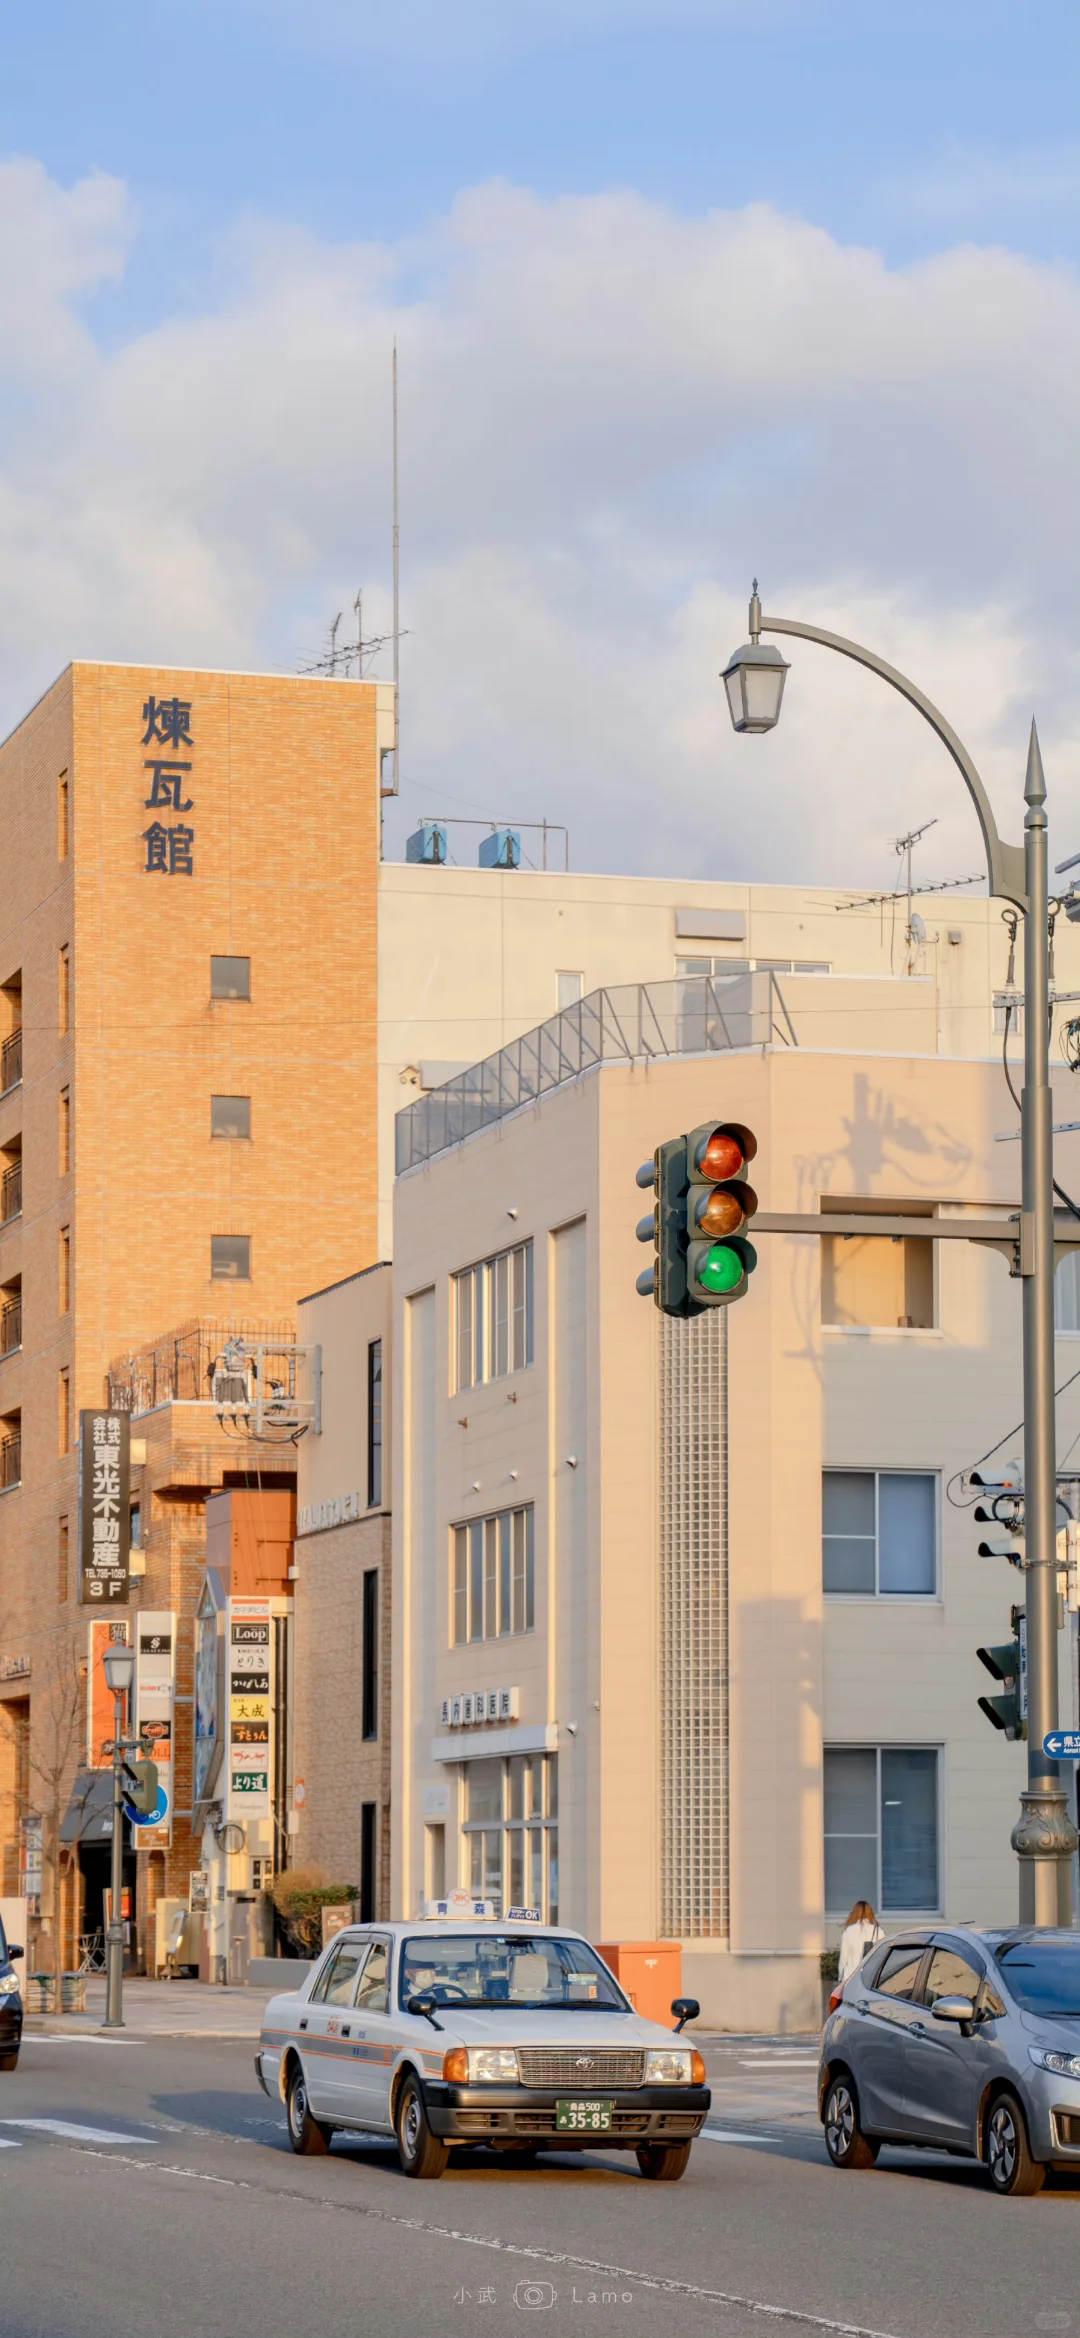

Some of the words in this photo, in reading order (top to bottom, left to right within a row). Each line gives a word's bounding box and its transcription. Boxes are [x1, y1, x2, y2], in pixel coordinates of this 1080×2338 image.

[140, 696, 194, 876] 煉瓦館
[92, 1445, 121, 1567] 東光不動産
[235, 1627, 266, 1642] Loop
[237, 1704, 264, 1718] 大成
[233, 1774, 267, 1791] より道
[437, 1902, 485, 1915] 青森
[525, 1910, 538, 1920] OK
[568, 2112, 610, 2128] 35-85
